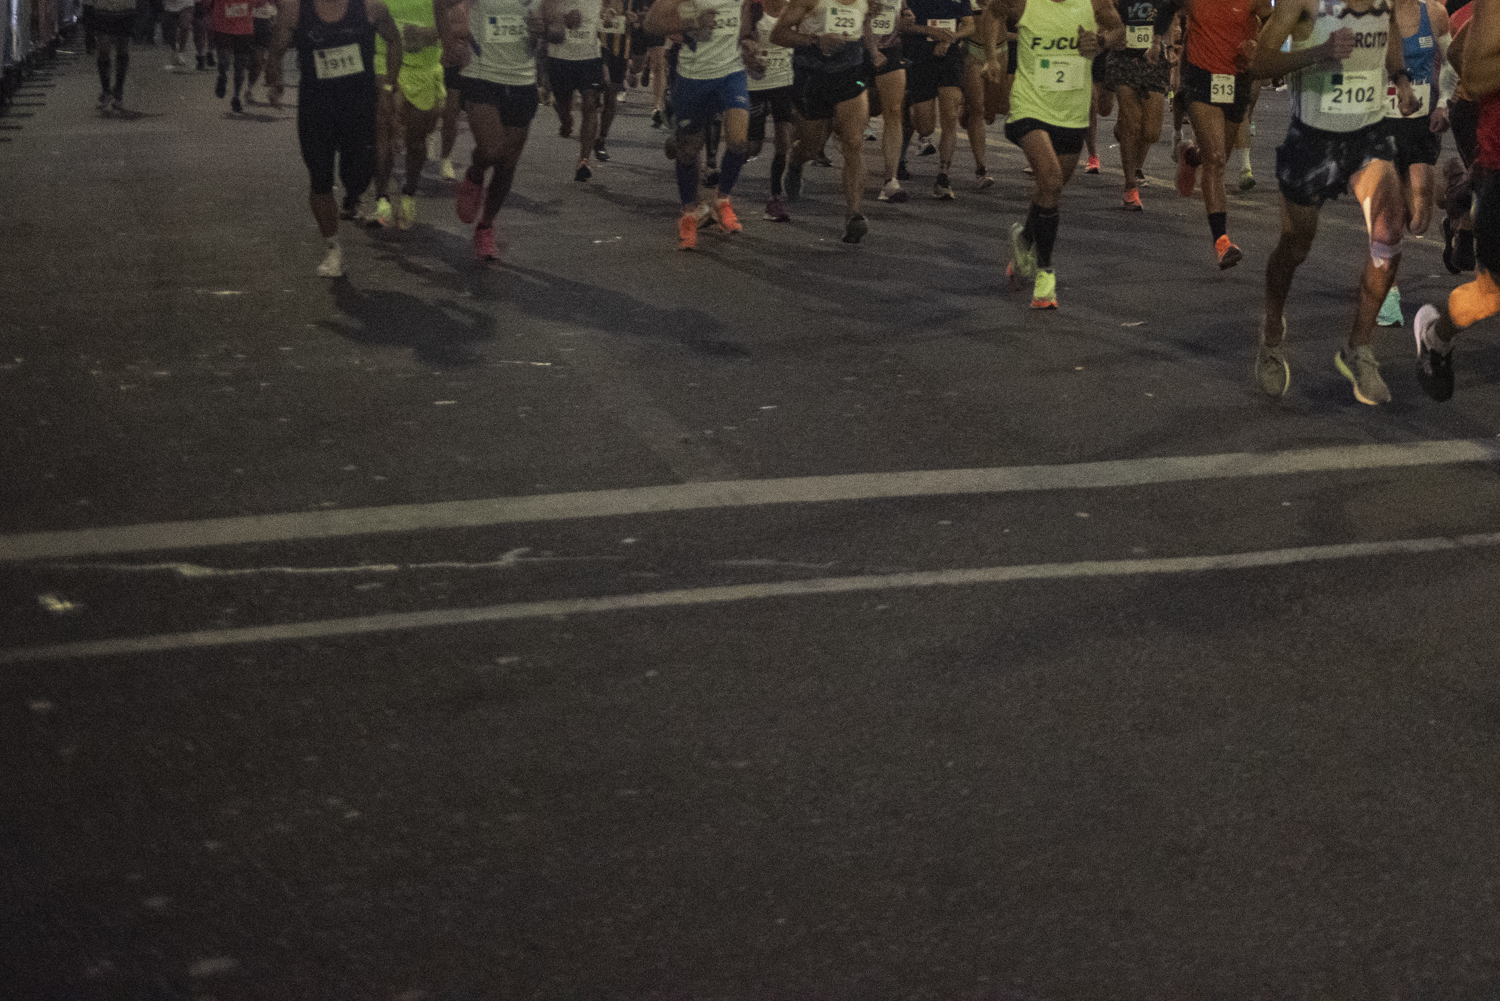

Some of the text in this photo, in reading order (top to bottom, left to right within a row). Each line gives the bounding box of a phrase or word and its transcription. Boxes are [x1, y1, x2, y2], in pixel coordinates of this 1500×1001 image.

[834, 15, 855, 28] 229
[1136, 33, 1150, 43] 60
[1353, 31, 1388, 48] RCITO
[1055, 70, 1065, 84] 2
[1212, 83, 1234, 96] 513
[1331, 87, 1376, 104] 2102
